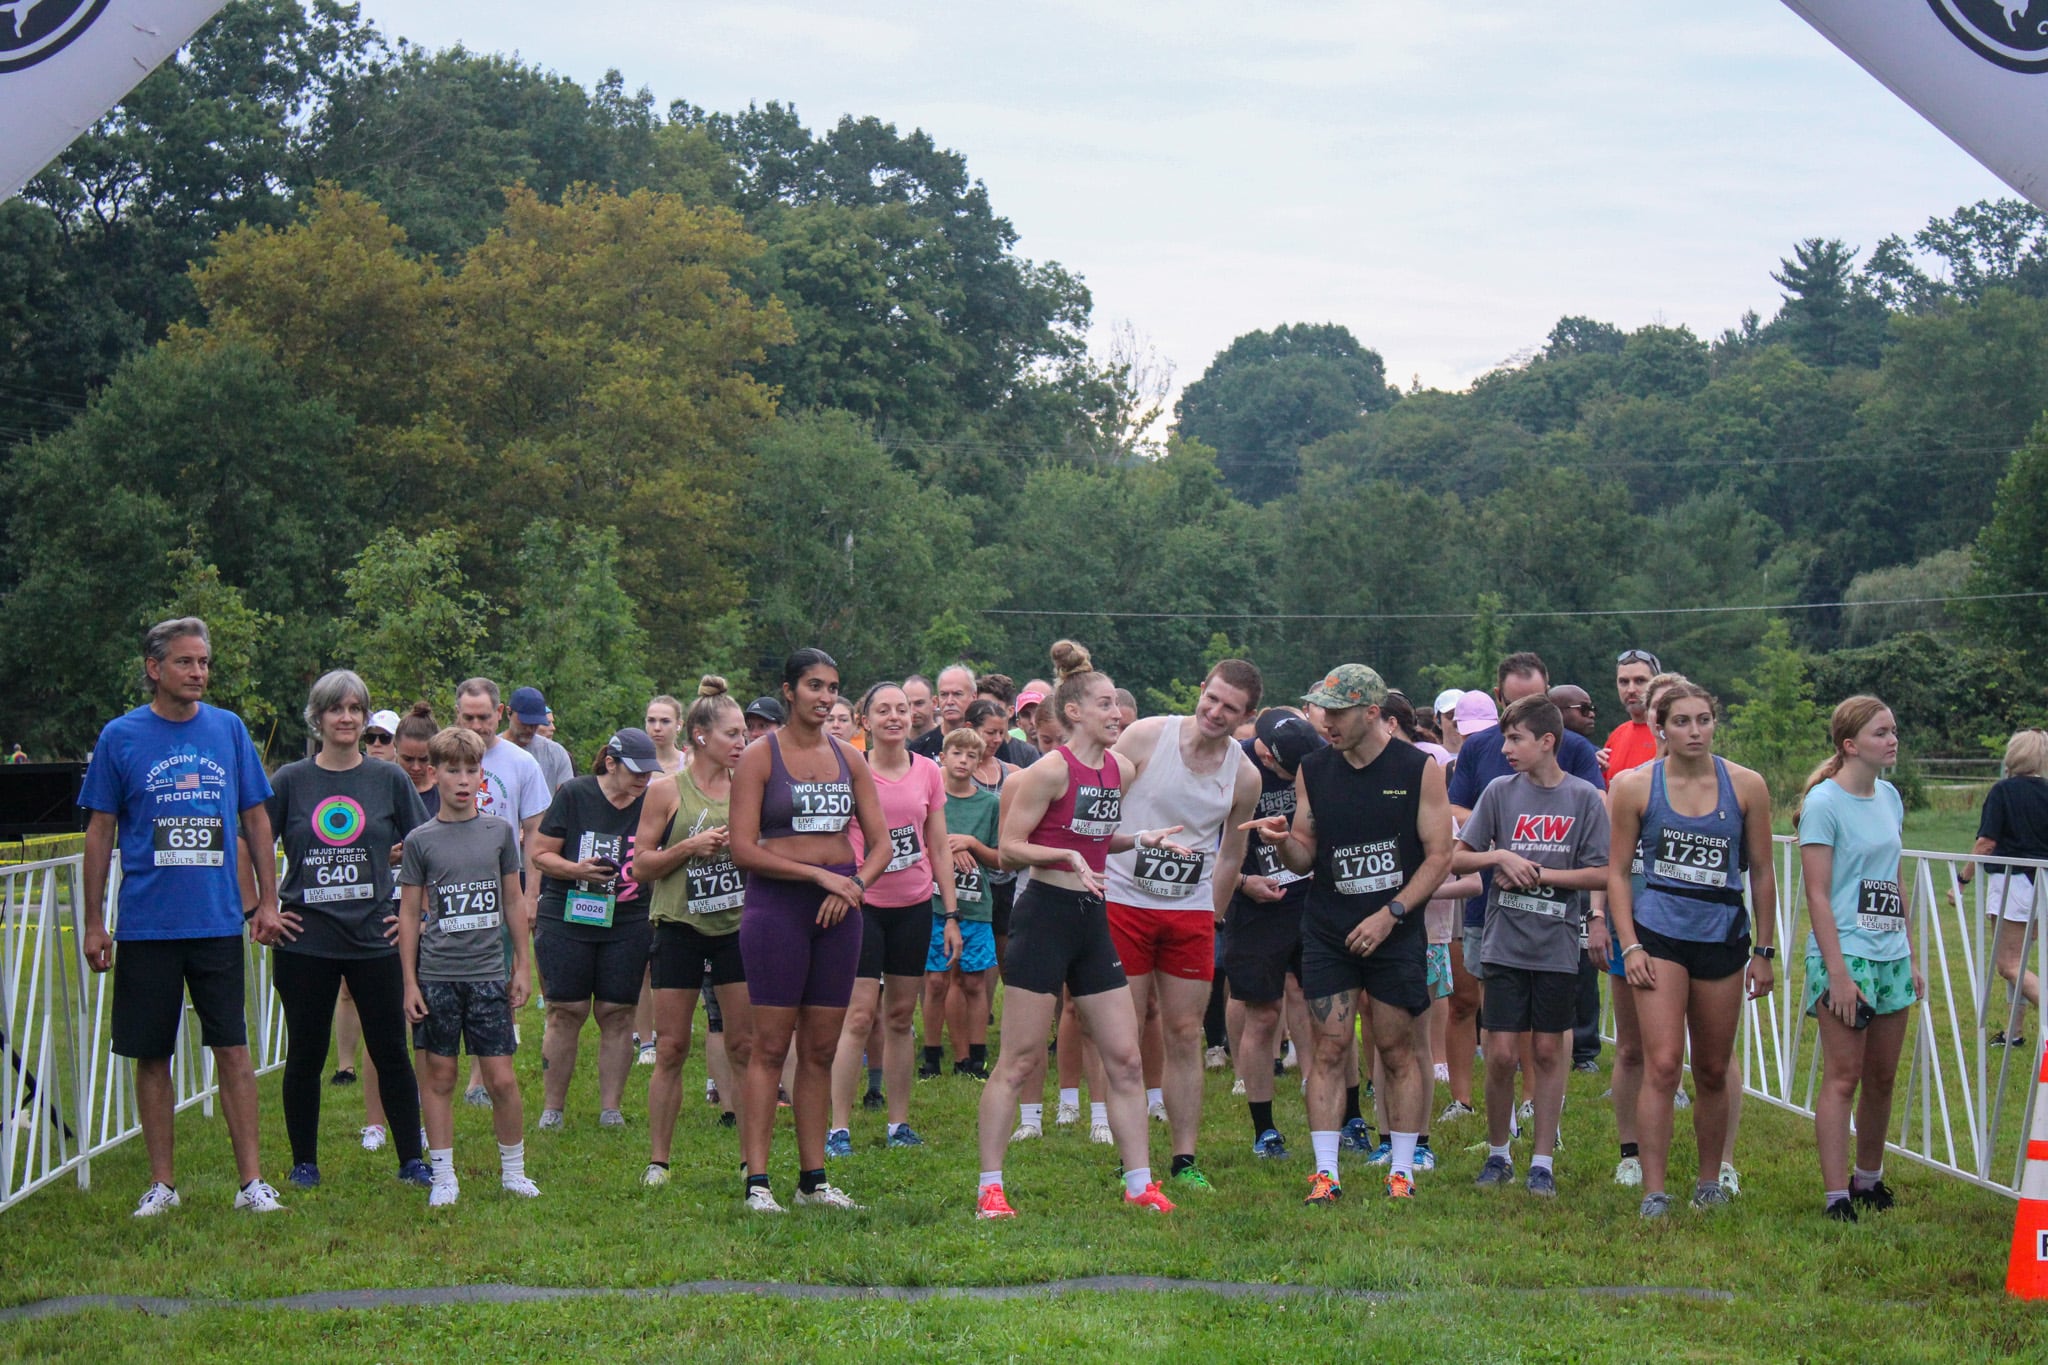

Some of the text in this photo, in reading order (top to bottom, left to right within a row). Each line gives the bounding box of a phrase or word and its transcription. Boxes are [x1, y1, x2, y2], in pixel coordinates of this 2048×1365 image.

[146, 754, 226, 783] JOGGIN' FOR
[794, 783, 824, 794] WOLF
[1080, 786, 1109, 798] WOLF
[156, 791, 221, 804] FROGMEN
[800, 794, 851, 815] 1250
[1087, 799, 1119, 819] 438
[158, 818, 223, 827] WOLF CREEK
[1511, 814, 1576, 843] KW
[168, 828, 212, 848] 639
[1663, 828, 1728, 848] WOLF CREEK
[1334, 840, 1396, 858] WOLF CREEK
[1663, 841, 1723, 868] 1739
[305, 853, 368, 866] WOLF CREEK
[1339, 852, 1395, 879] 1708
[1660, 862, 1675, 870] LIVE
[317, 864, 359, 885] 640
[1144, 858, 1196, 882] 707
[1660, 868, 1692, 881] RESULTS
[438, 883, 466, 895] WOLF
[693, 871, 743, 898] 1761
[443, 891, 496, 916] 1749
[576, 903, 604, 914] 00026
[693, 900, 709, 908] LIVE
[694, 904, 727, 912] RESULTS
[1502, 899, 1534, 911] RESULTS
[1862, 914, 1878, 922] LIVE
[443, 922, 475, 931] RESULTS
